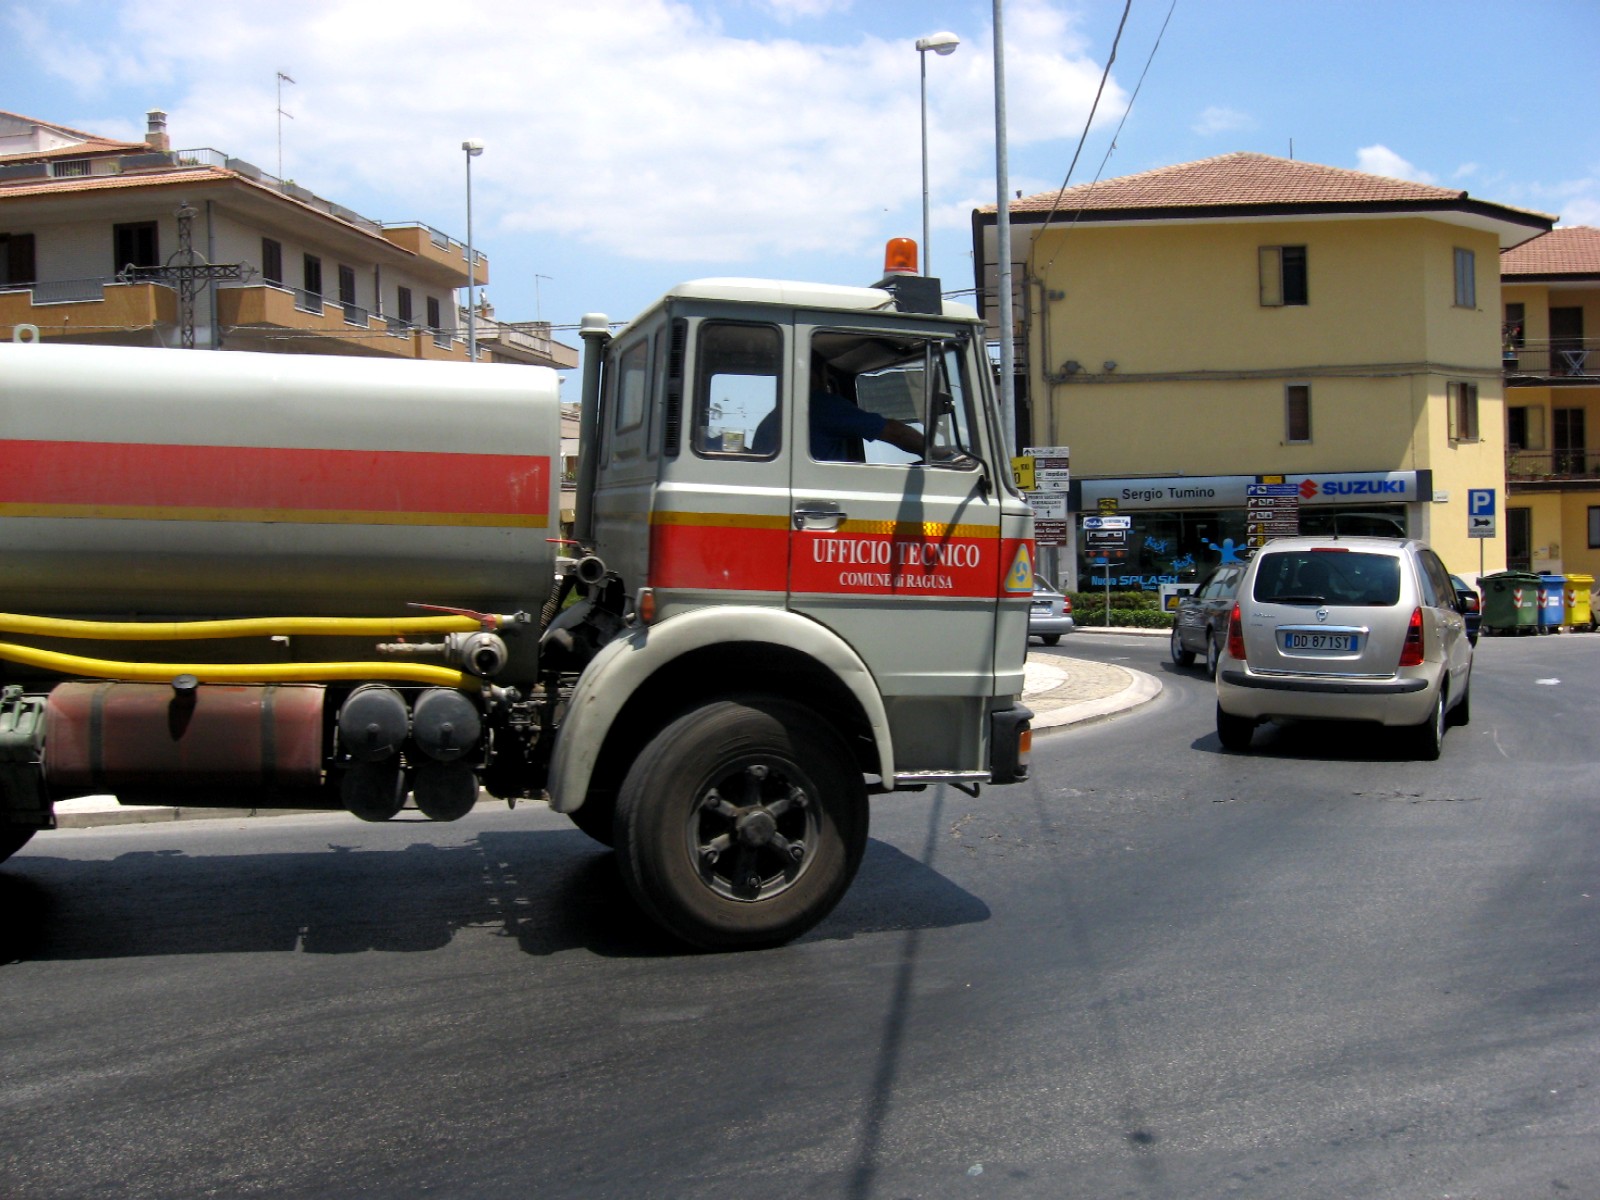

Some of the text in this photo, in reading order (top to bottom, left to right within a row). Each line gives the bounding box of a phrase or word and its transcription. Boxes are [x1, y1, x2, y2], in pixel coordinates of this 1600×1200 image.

[1122, 487, 1215, 501] Sergio Tumino
[1322, 480, 1406, 495] SUZUKI
[1472, 491, 1491, 514] P
[812, 538, 980, 568] UFFICIO TECNICO
[839, 571, 954, 589] COMUNE di RAGUSA
[1119, 575, 1180, 586] SPLASH
[1293, 635, 1308, 648] DD
